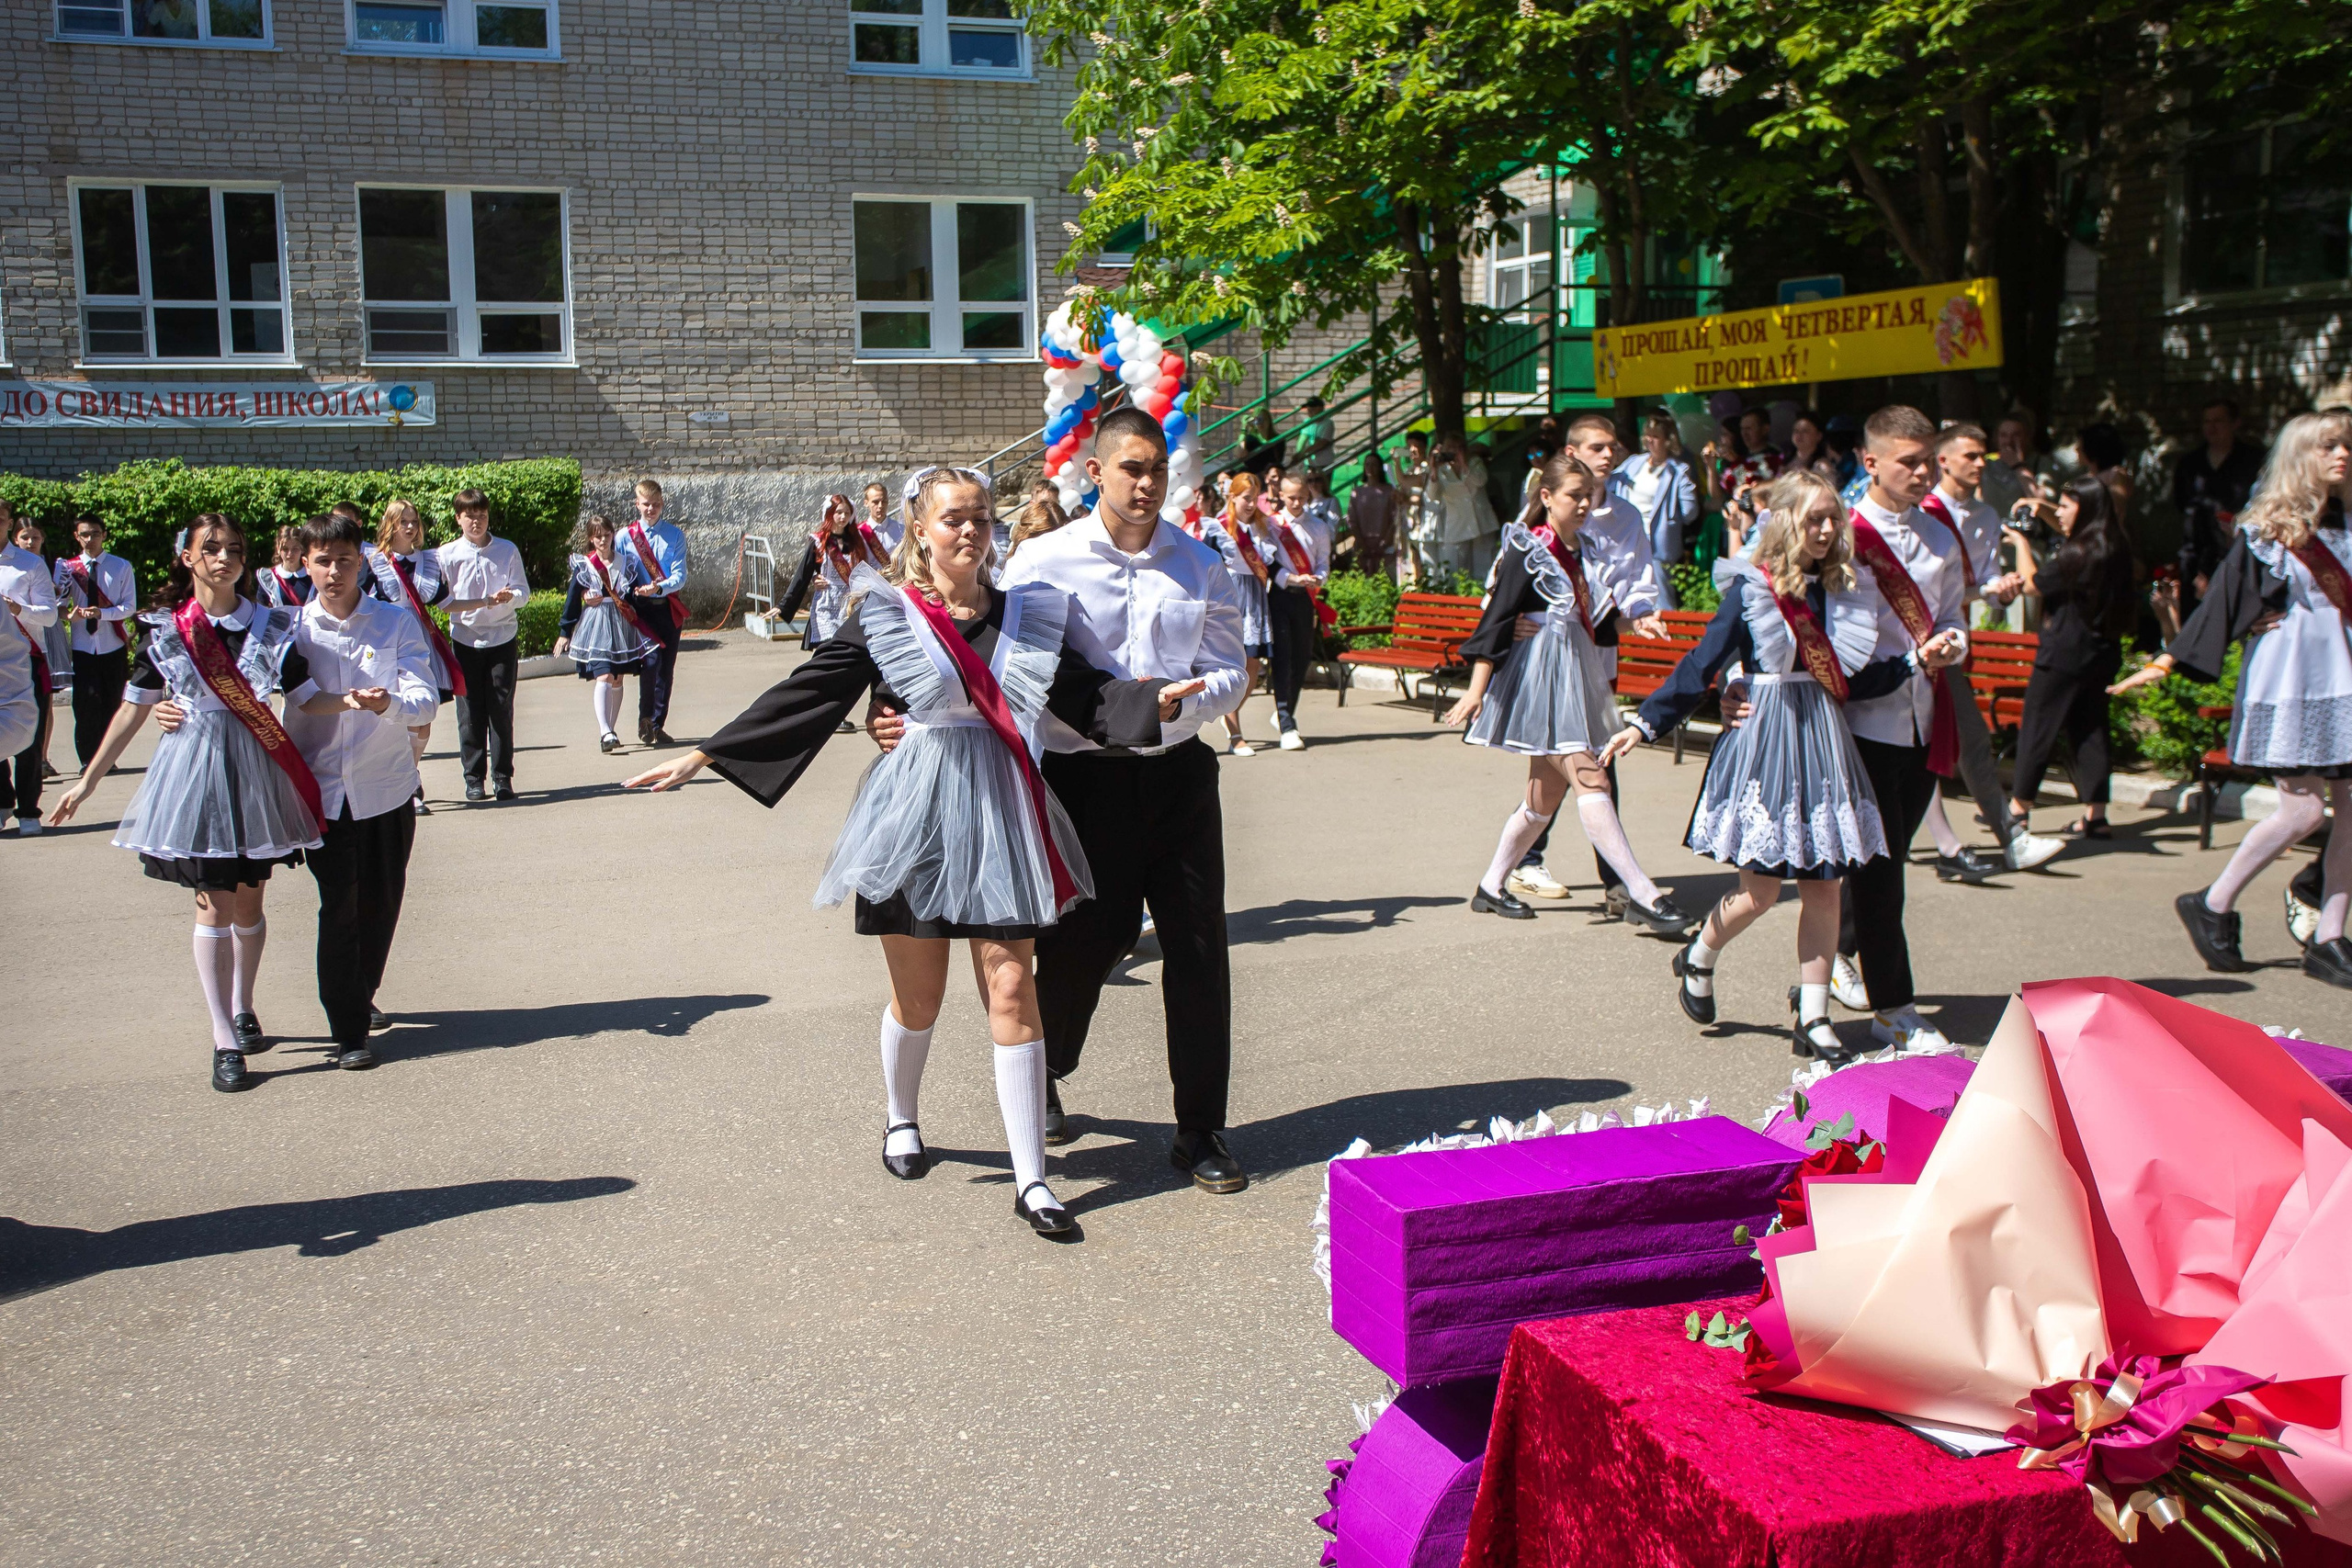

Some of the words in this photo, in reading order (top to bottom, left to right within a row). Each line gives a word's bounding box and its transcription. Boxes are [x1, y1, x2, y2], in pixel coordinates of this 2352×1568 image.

[1621, 318, 1714, 357] ПРОЩАЙ,
[1719, 318, 1768, 347] МОЯ
[1780, 297, 1934, 341] ЧЕТВЕРТАЯ,
[2, 390, 48, 422] ДО
[56, 389, 247, 423] СВИДАНИЯ,
[252, 389, 380, 418] ШКОЛА!
